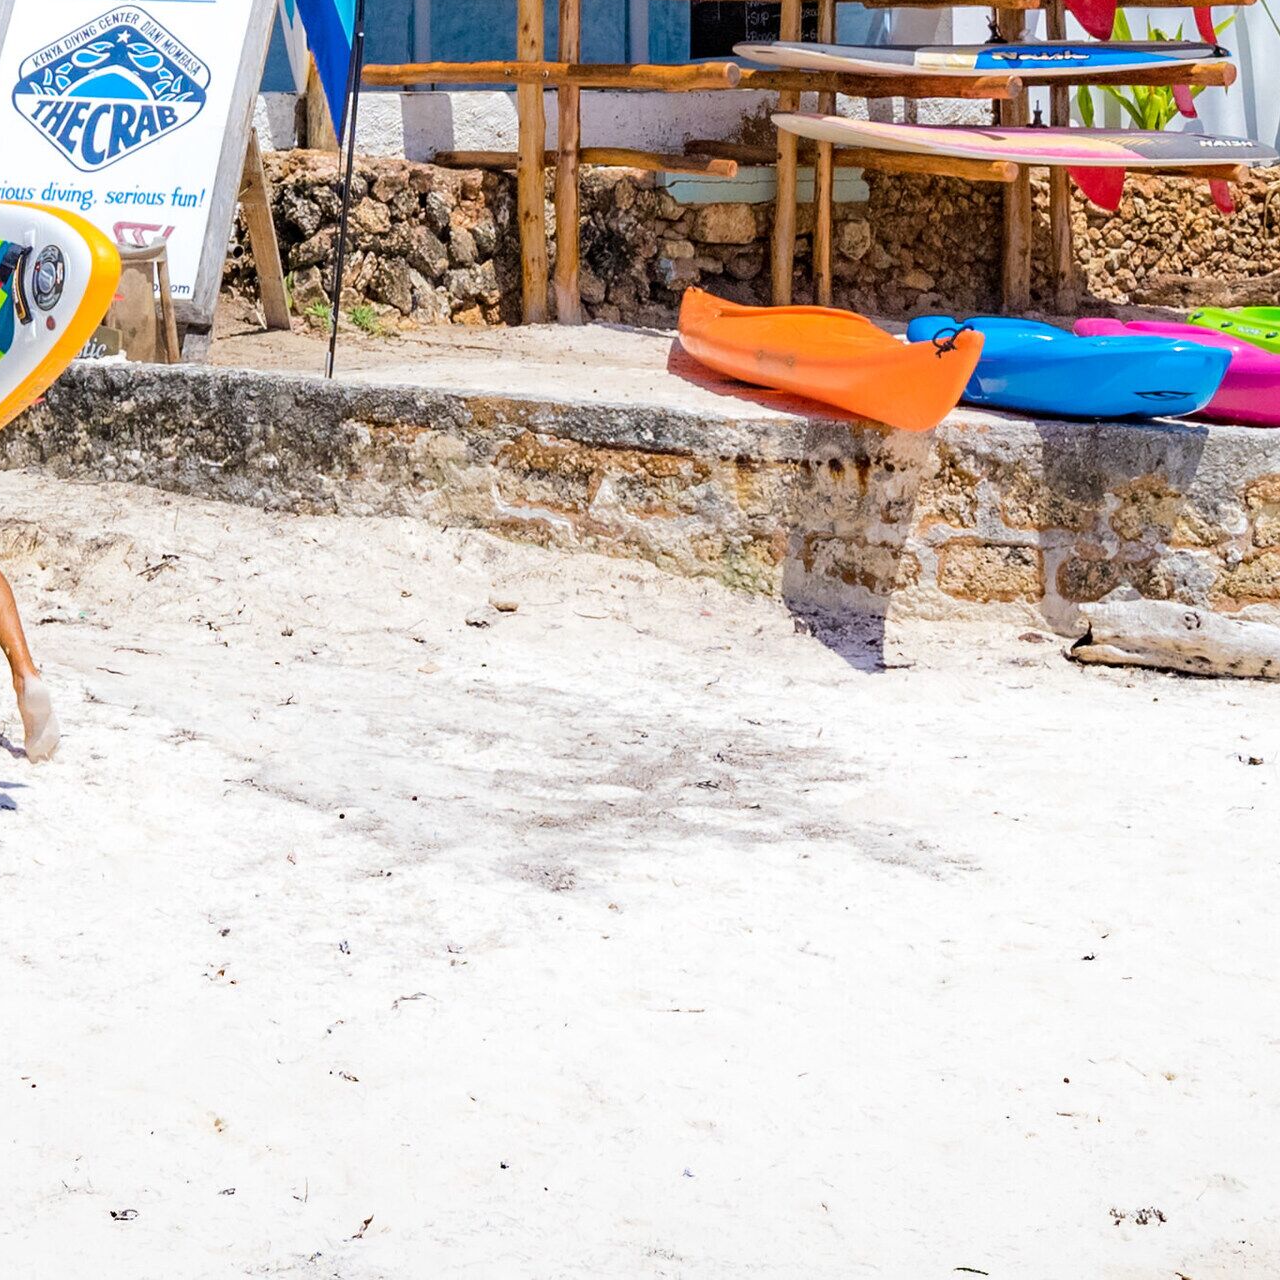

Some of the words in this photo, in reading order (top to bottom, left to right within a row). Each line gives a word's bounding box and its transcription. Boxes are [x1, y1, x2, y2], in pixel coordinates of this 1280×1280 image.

[32, 46, 63, 68] KENYA
[65, 26, 97, 50] DIVING
[98, 12, 140, 29] CENTER
[140, 21, 164, 43] DIANI
[161, 39, 202, 76] MOMBASA
[41, 182, 97, 211] diving,
[104, 184, 166, 206] serious
[170, 186, 206, 208] fun!
